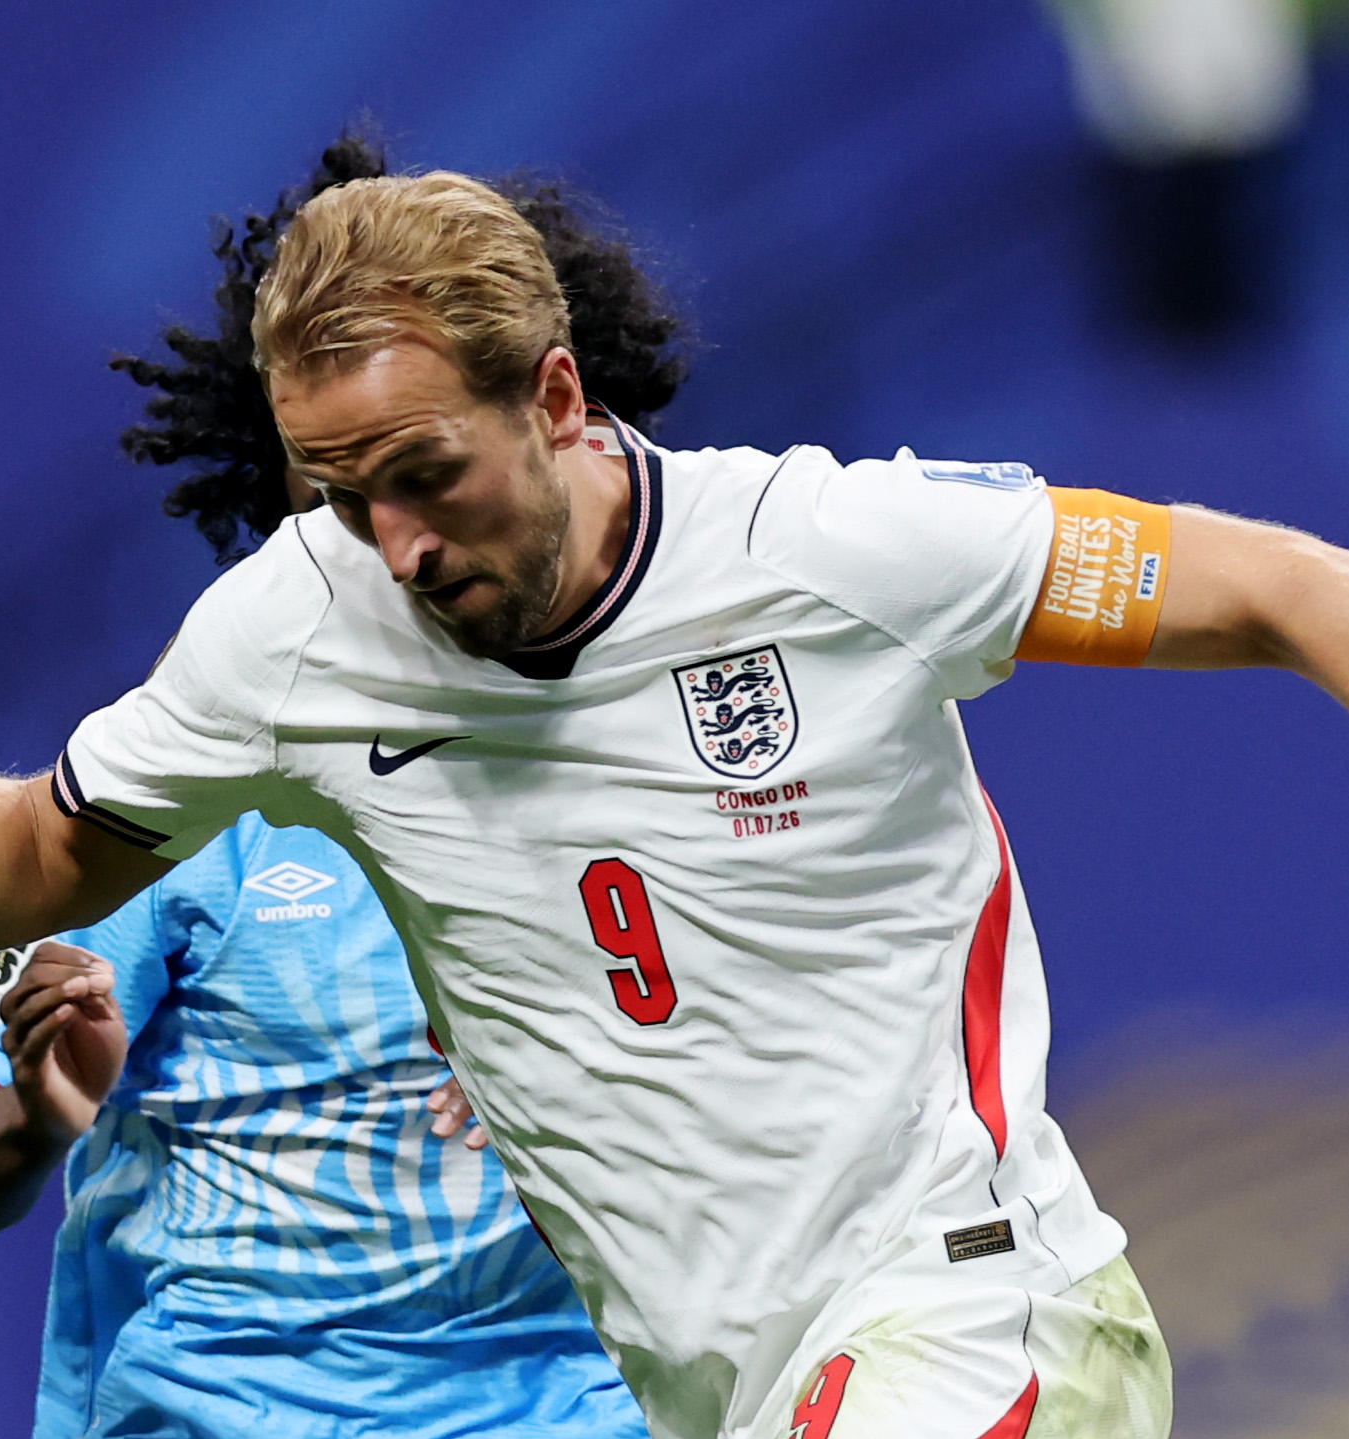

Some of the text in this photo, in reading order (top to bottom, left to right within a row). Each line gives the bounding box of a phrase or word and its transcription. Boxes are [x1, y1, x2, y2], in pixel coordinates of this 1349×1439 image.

[1044, 513, 1080, 614] FOOTBALL
[1065, 516, 1112, 621] UNITES
[1099, 514, 1142, 631] the World
[1140, 556, 1156, 595] FIFA
[716, 780, 809, 811] CONGO DR
[733, 810, 801, 838] 01.07.26
[255, 901, 333, 923] umbro
[578, 857, 678, 1027] 9
